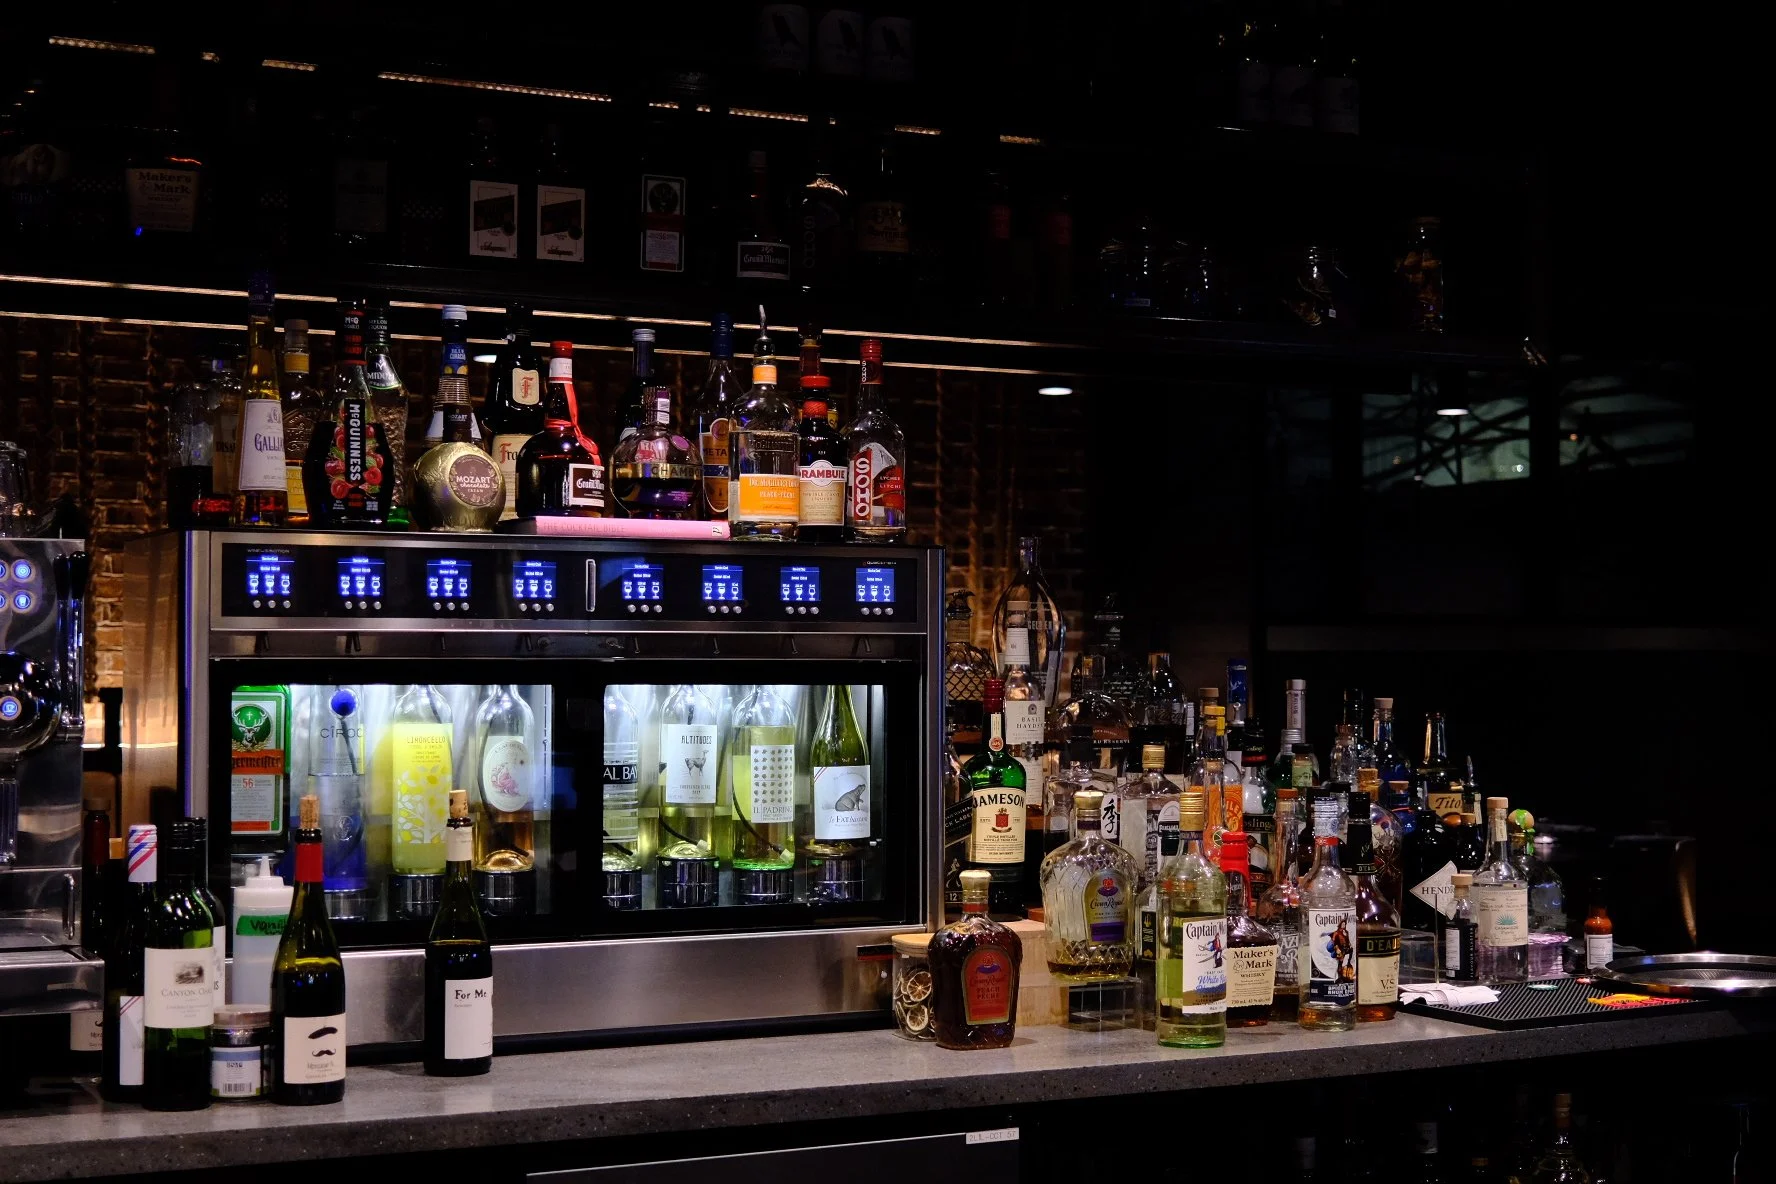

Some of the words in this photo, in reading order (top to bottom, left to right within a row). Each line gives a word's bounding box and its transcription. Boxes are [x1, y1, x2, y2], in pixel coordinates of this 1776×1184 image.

[138, 172, 192, 183] Maker's
[154, 183, 193, 194] Mark
[456, 475, 491, 483] MOZART
[855, 457, 870, 517] SOHO
[681, 735, 713, 745] ALTITUDES
[242, 778, 254, 789] 56
[973, 793, 1025, 809] JAMESON
[949, 893, 958, 902] 12
[1315, 913, 1342, 929] Captain
[1186, 923, 1216, 940] Captain
[1233, 948, 1274, 960] Maker's
[1245, 959, 1273, 970] Mark
[161, 987, 196, 997] CANYON
[455, 989, 471, 1000] For
[474, 989, 488, 999] Me
